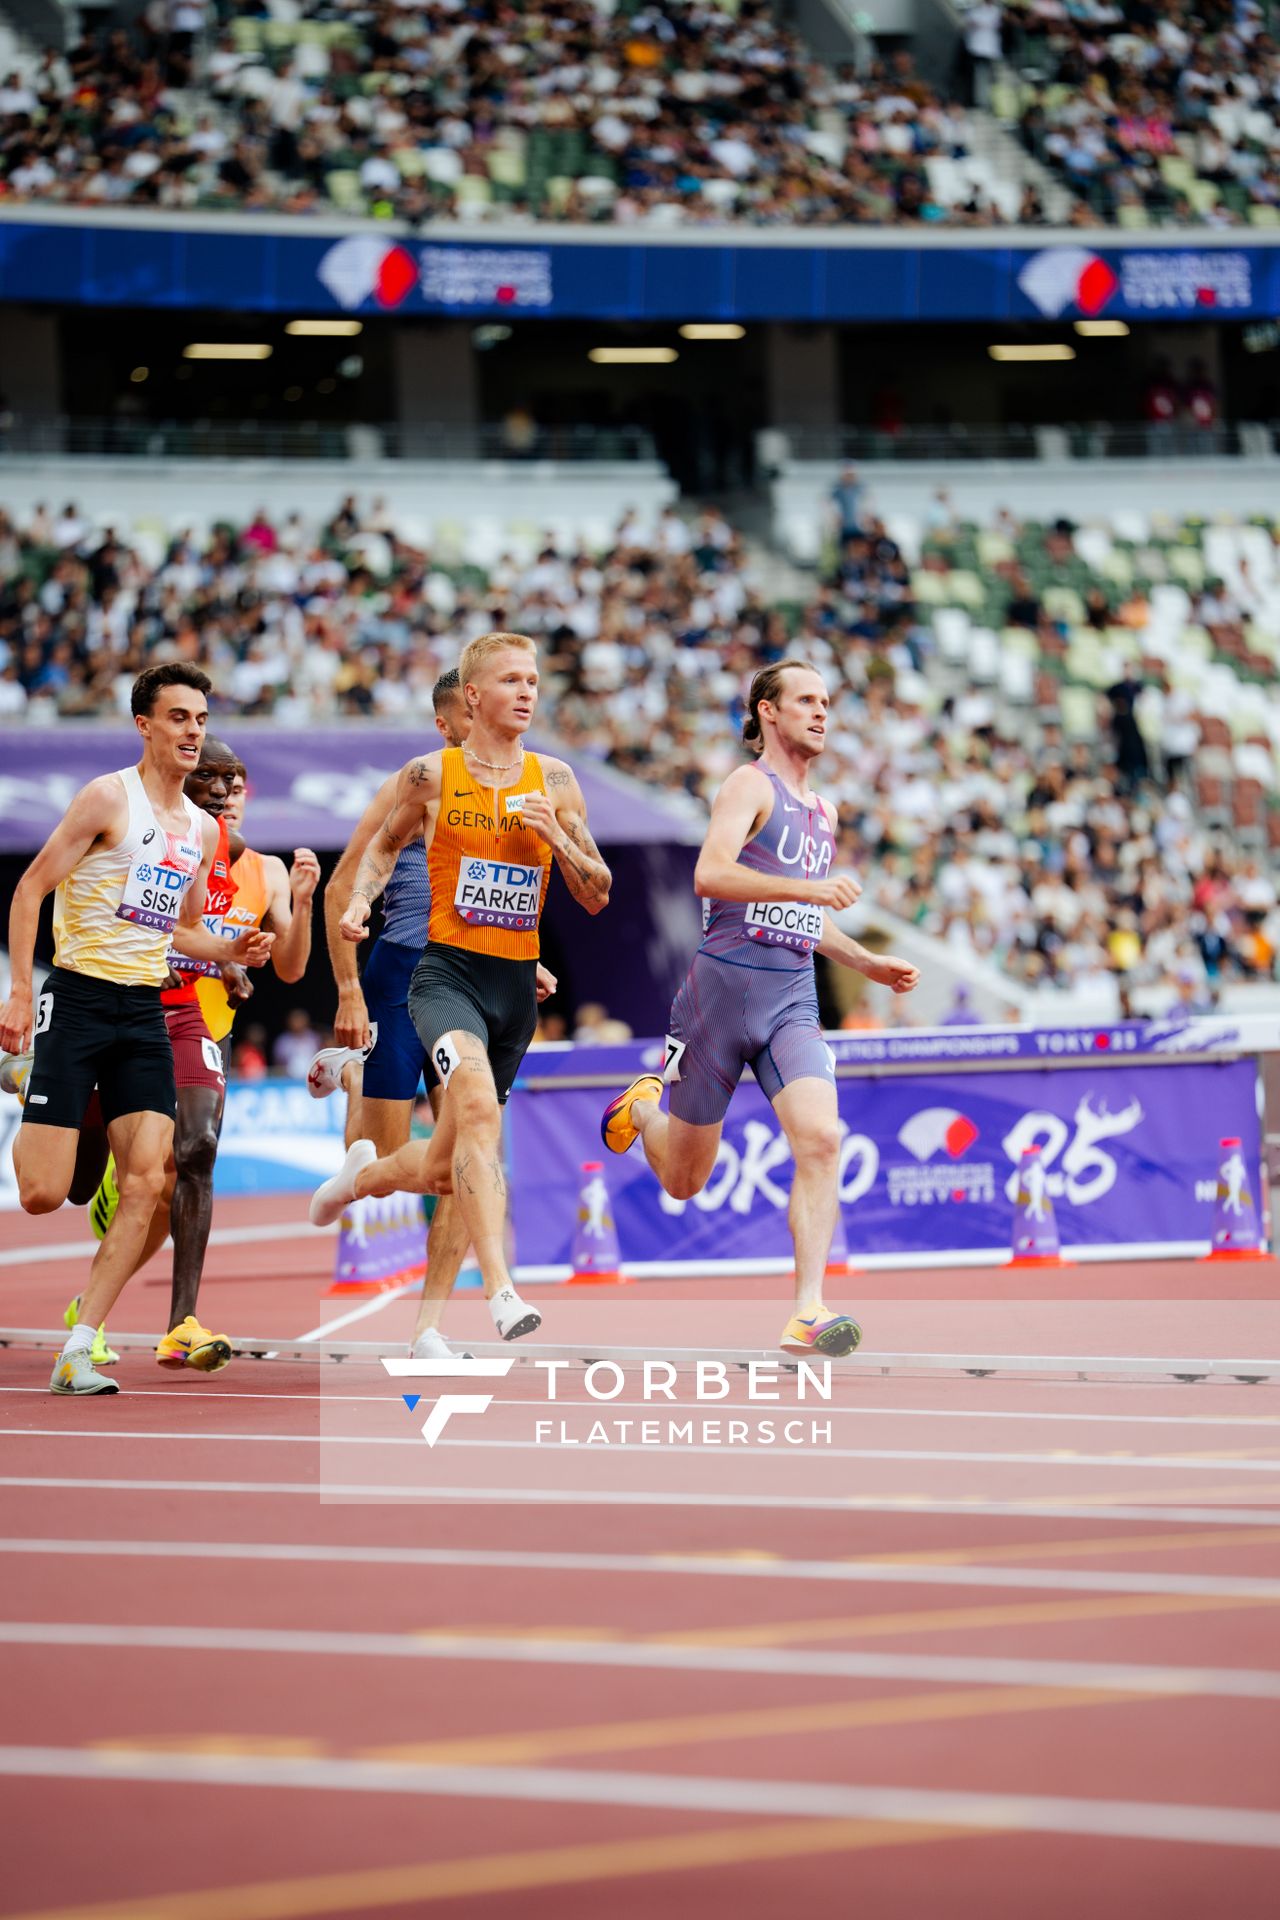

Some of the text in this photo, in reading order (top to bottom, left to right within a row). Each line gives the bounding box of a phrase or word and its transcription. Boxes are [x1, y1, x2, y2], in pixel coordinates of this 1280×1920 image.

[777, 825, 832, 879] USA
[487, 863, 539, 888] TDK
[140, 888, 178, 915] SISK
[461, 884, 538, 912] FARKEN
[752, 902, 822, 937] HOCKER
[37, 1000, 47, 1029] 5
[436, 1048, 451, 1075] 8
[664, 1044, 678, 1067] 7
